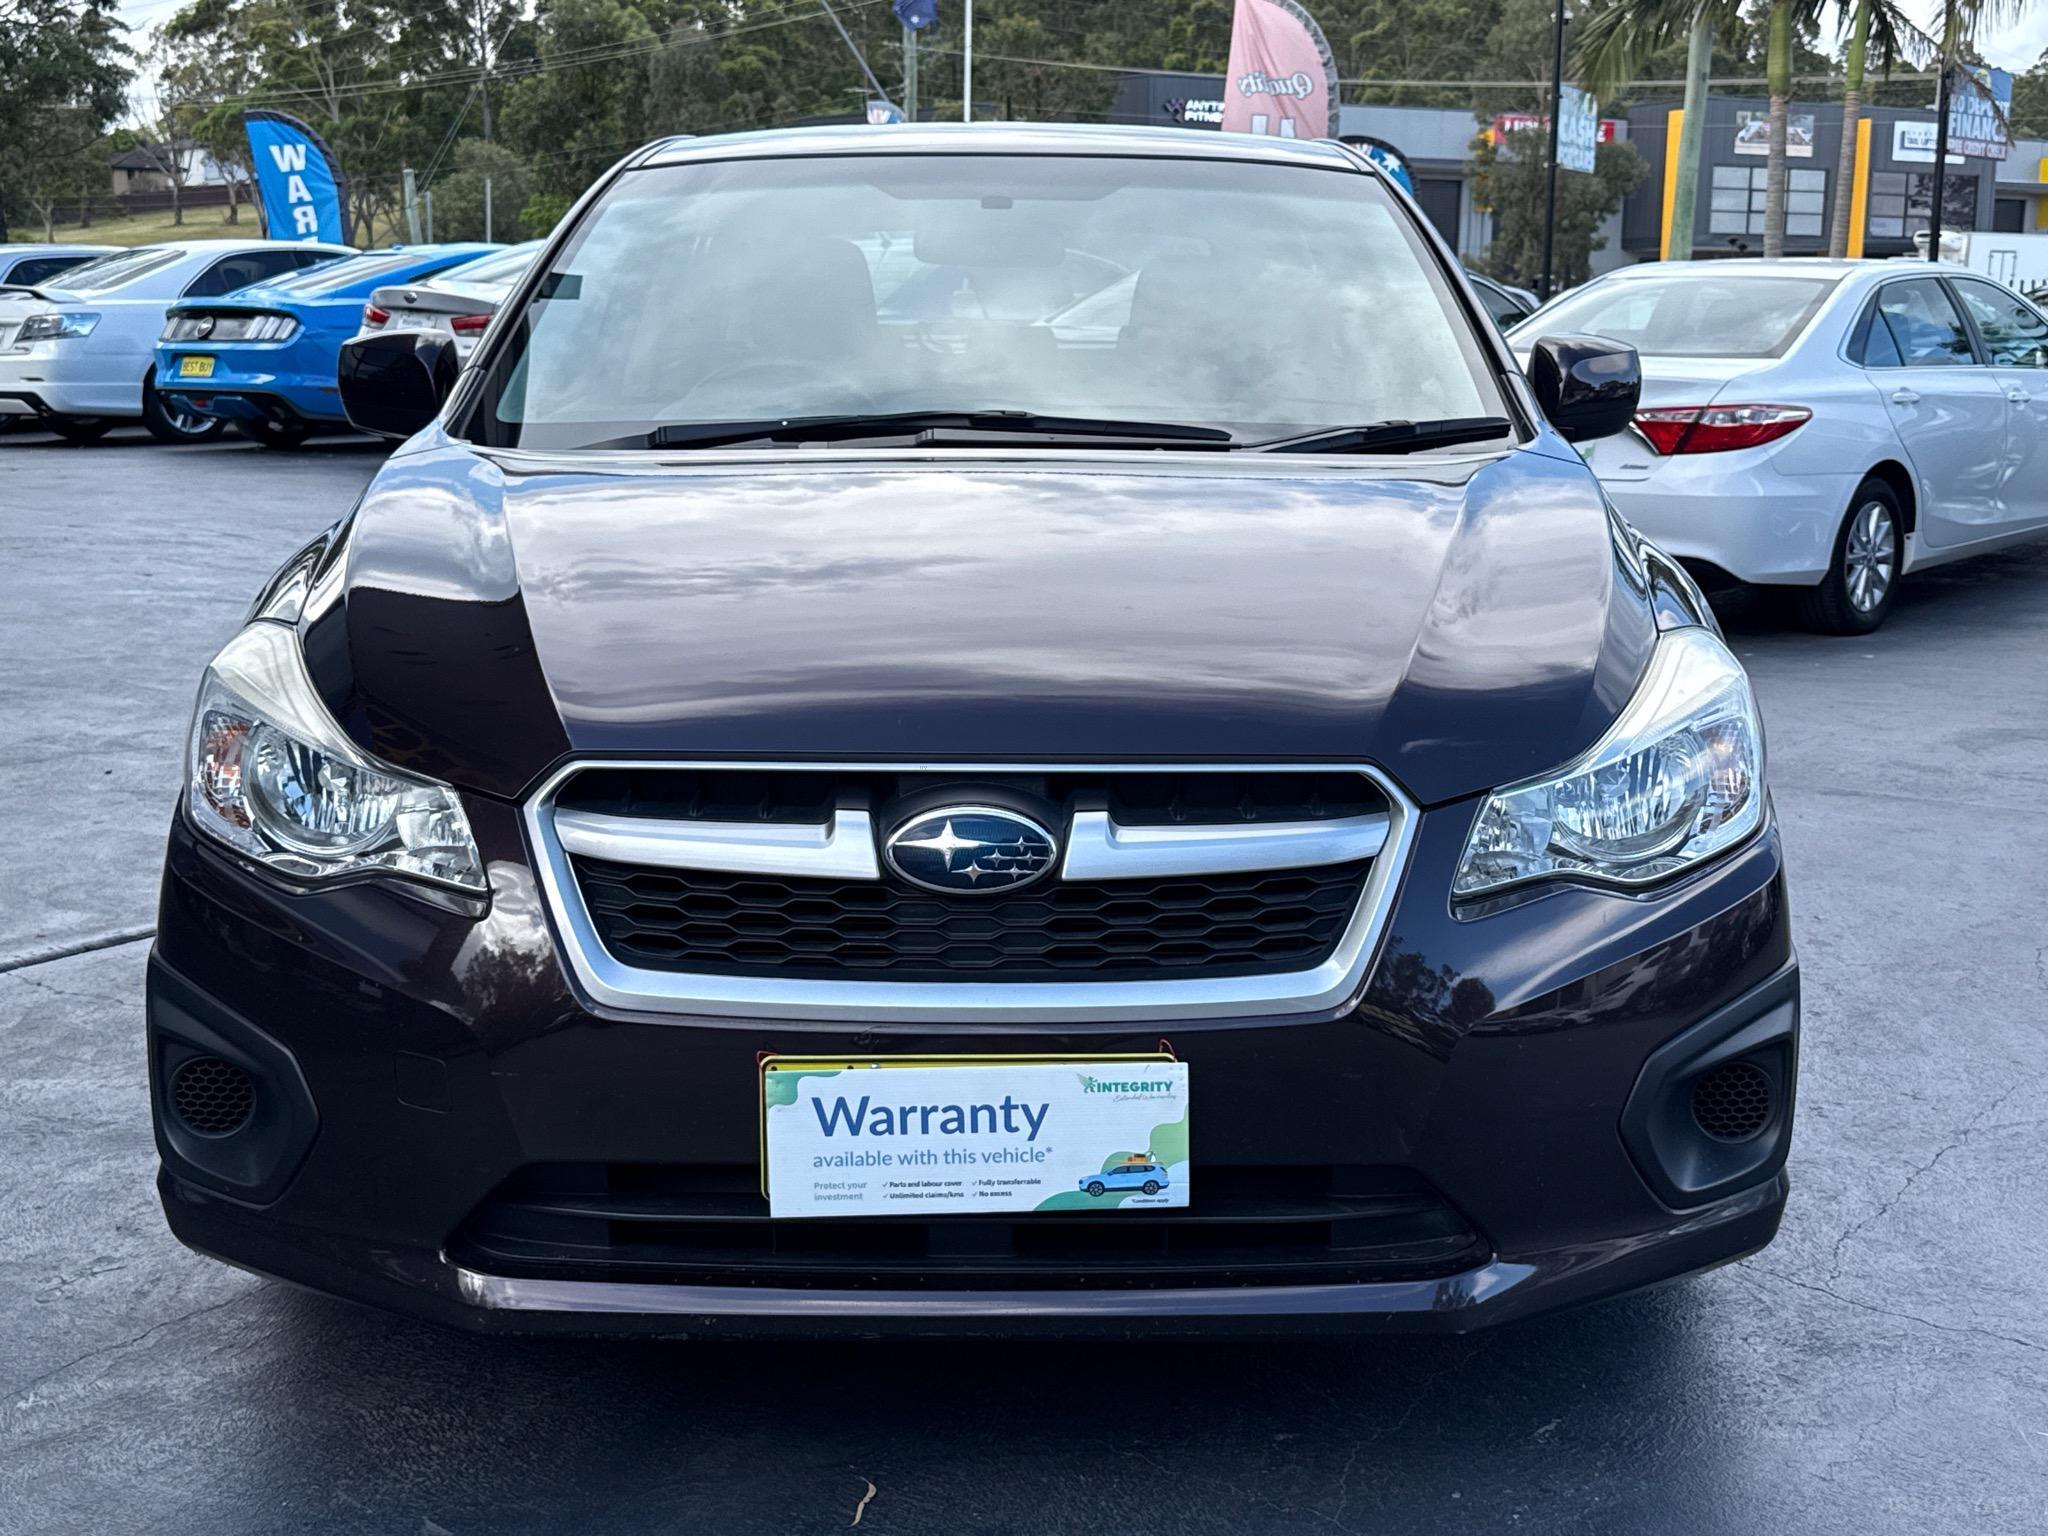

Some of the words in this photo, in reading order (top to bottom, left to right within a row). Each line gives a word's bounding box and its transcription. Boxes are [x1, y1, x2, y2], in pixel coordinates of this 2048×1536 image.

[1185, 99, 1225, 111] ANYTI
[1185, 110, 1223, 122] FITNE
[1948, 112, 2007, 143] FINANC
[183, 361, 199, 372] BEST
[199, 361, 213, 372] BUY
[1097, 1081, 1173, 1092] INTEGRITY
[811, 1095, 1050, 1141] Warranty
[813, 1150, 893, 1168] available
[897, 1149, 938, 1166] with
[944, 1148, 977, 1165] this
[814, 1182, 845, 1190] Protect
[847, 1182, 868, 1191] your
[978, 1179, 995, 1187] Fully
[996, 1178, 1042, 1186] transferrable
[814, 1193, 863, 1201] investment
[925, 1191, 965, 1199] claims/kms
